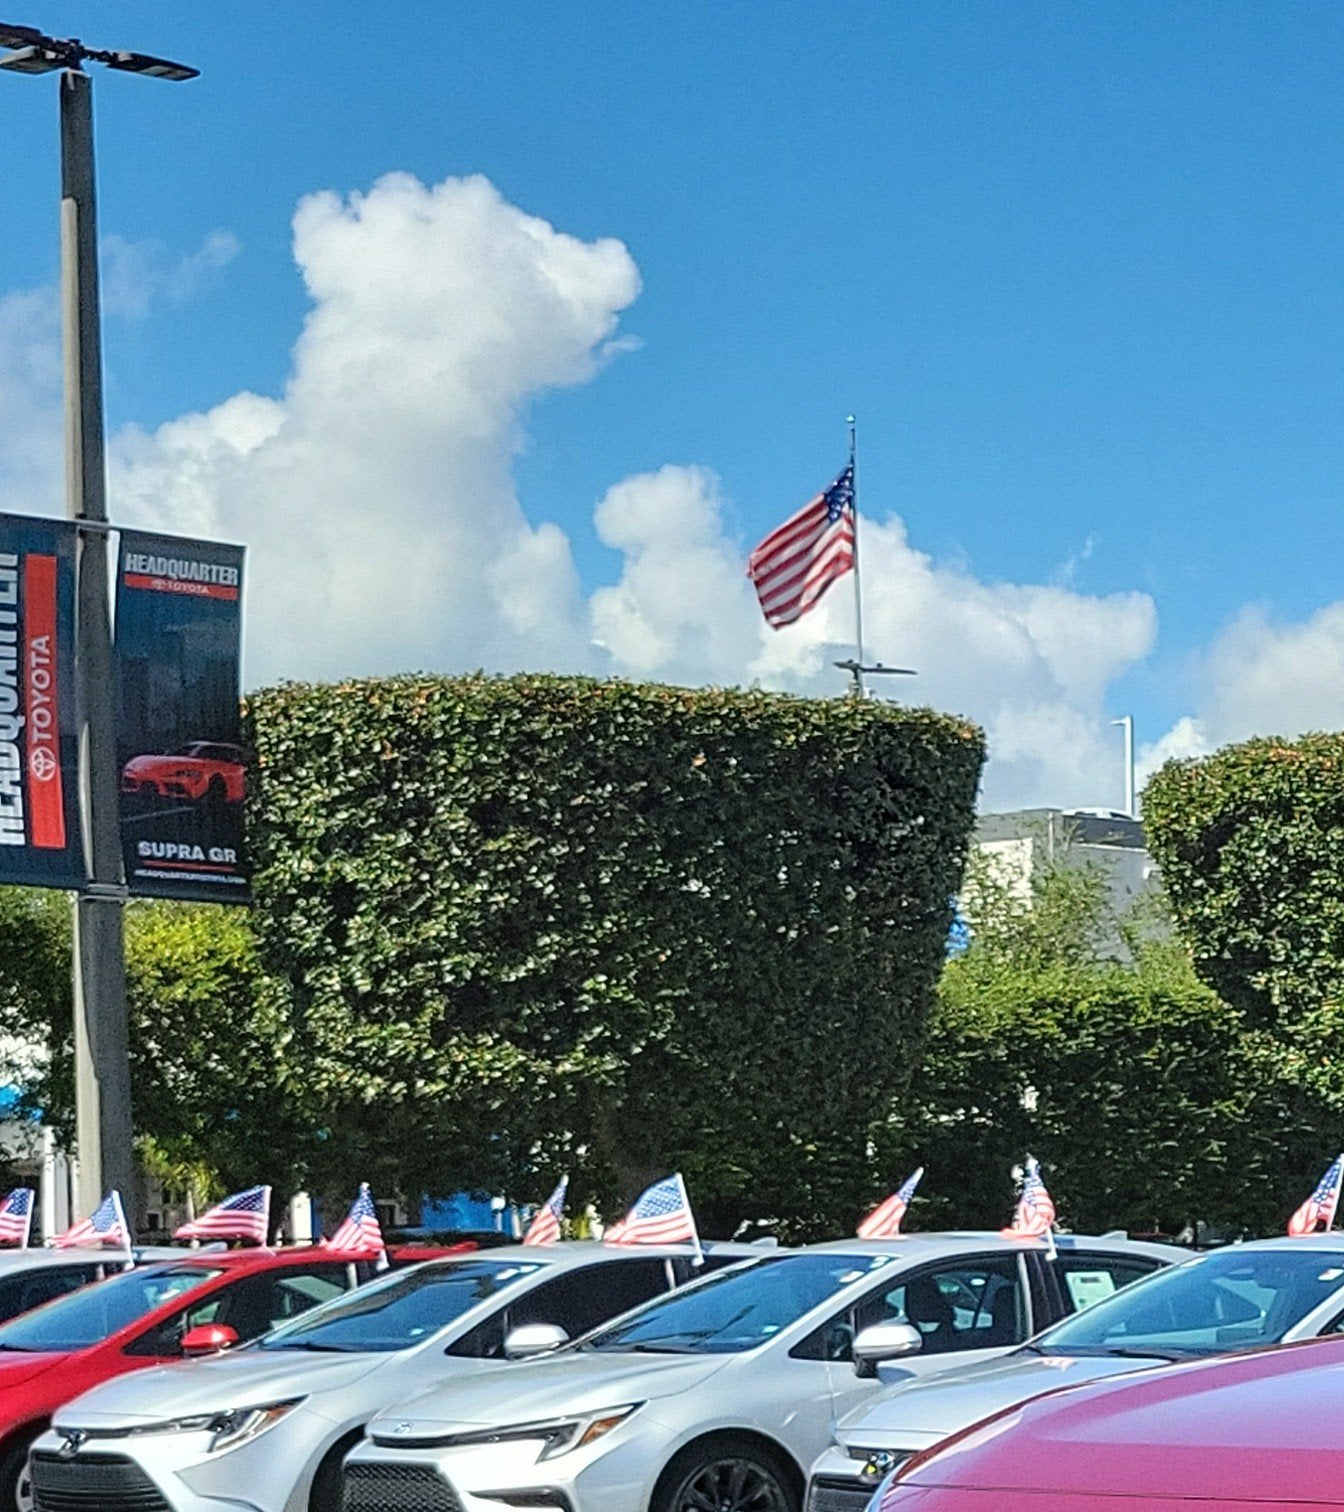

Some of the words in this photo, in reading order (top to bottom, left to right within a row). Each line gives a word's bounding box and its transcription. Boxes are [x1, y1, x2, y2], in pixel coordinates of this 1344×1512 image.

[125, 552, 239, 586] HEADQUARTER
[30, 634, 53, 744] TOYOTA
[137, 840, 206, 861] SUPRA
[207, 847, 238, 864] GR
